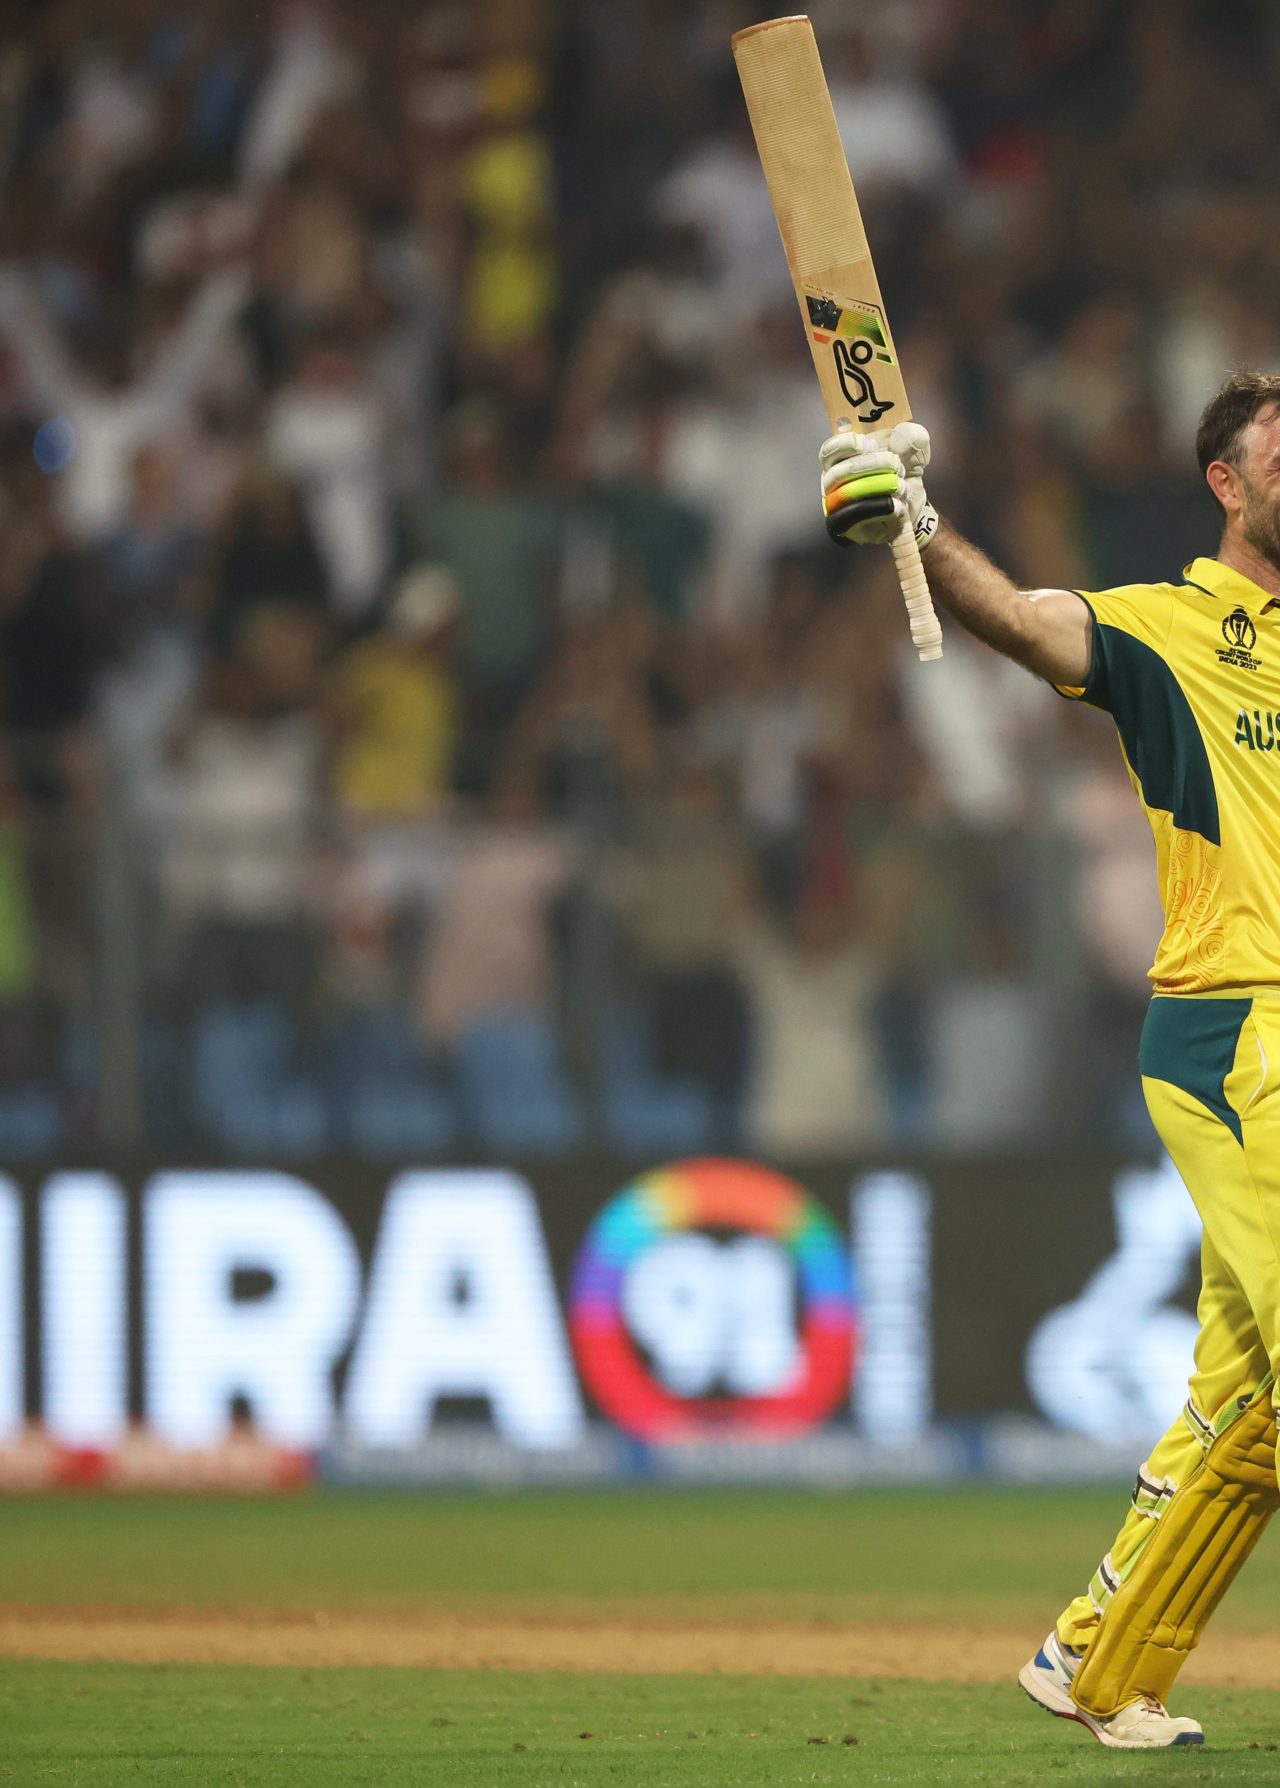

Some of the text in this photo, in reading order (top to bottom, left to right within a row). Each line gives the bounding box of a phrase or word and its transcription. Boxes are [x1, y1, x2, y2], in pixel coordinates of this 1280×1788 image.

[1218, 655, 1257, 671] INDIA 2023
[0, 1168, 591, 1452] IRA
